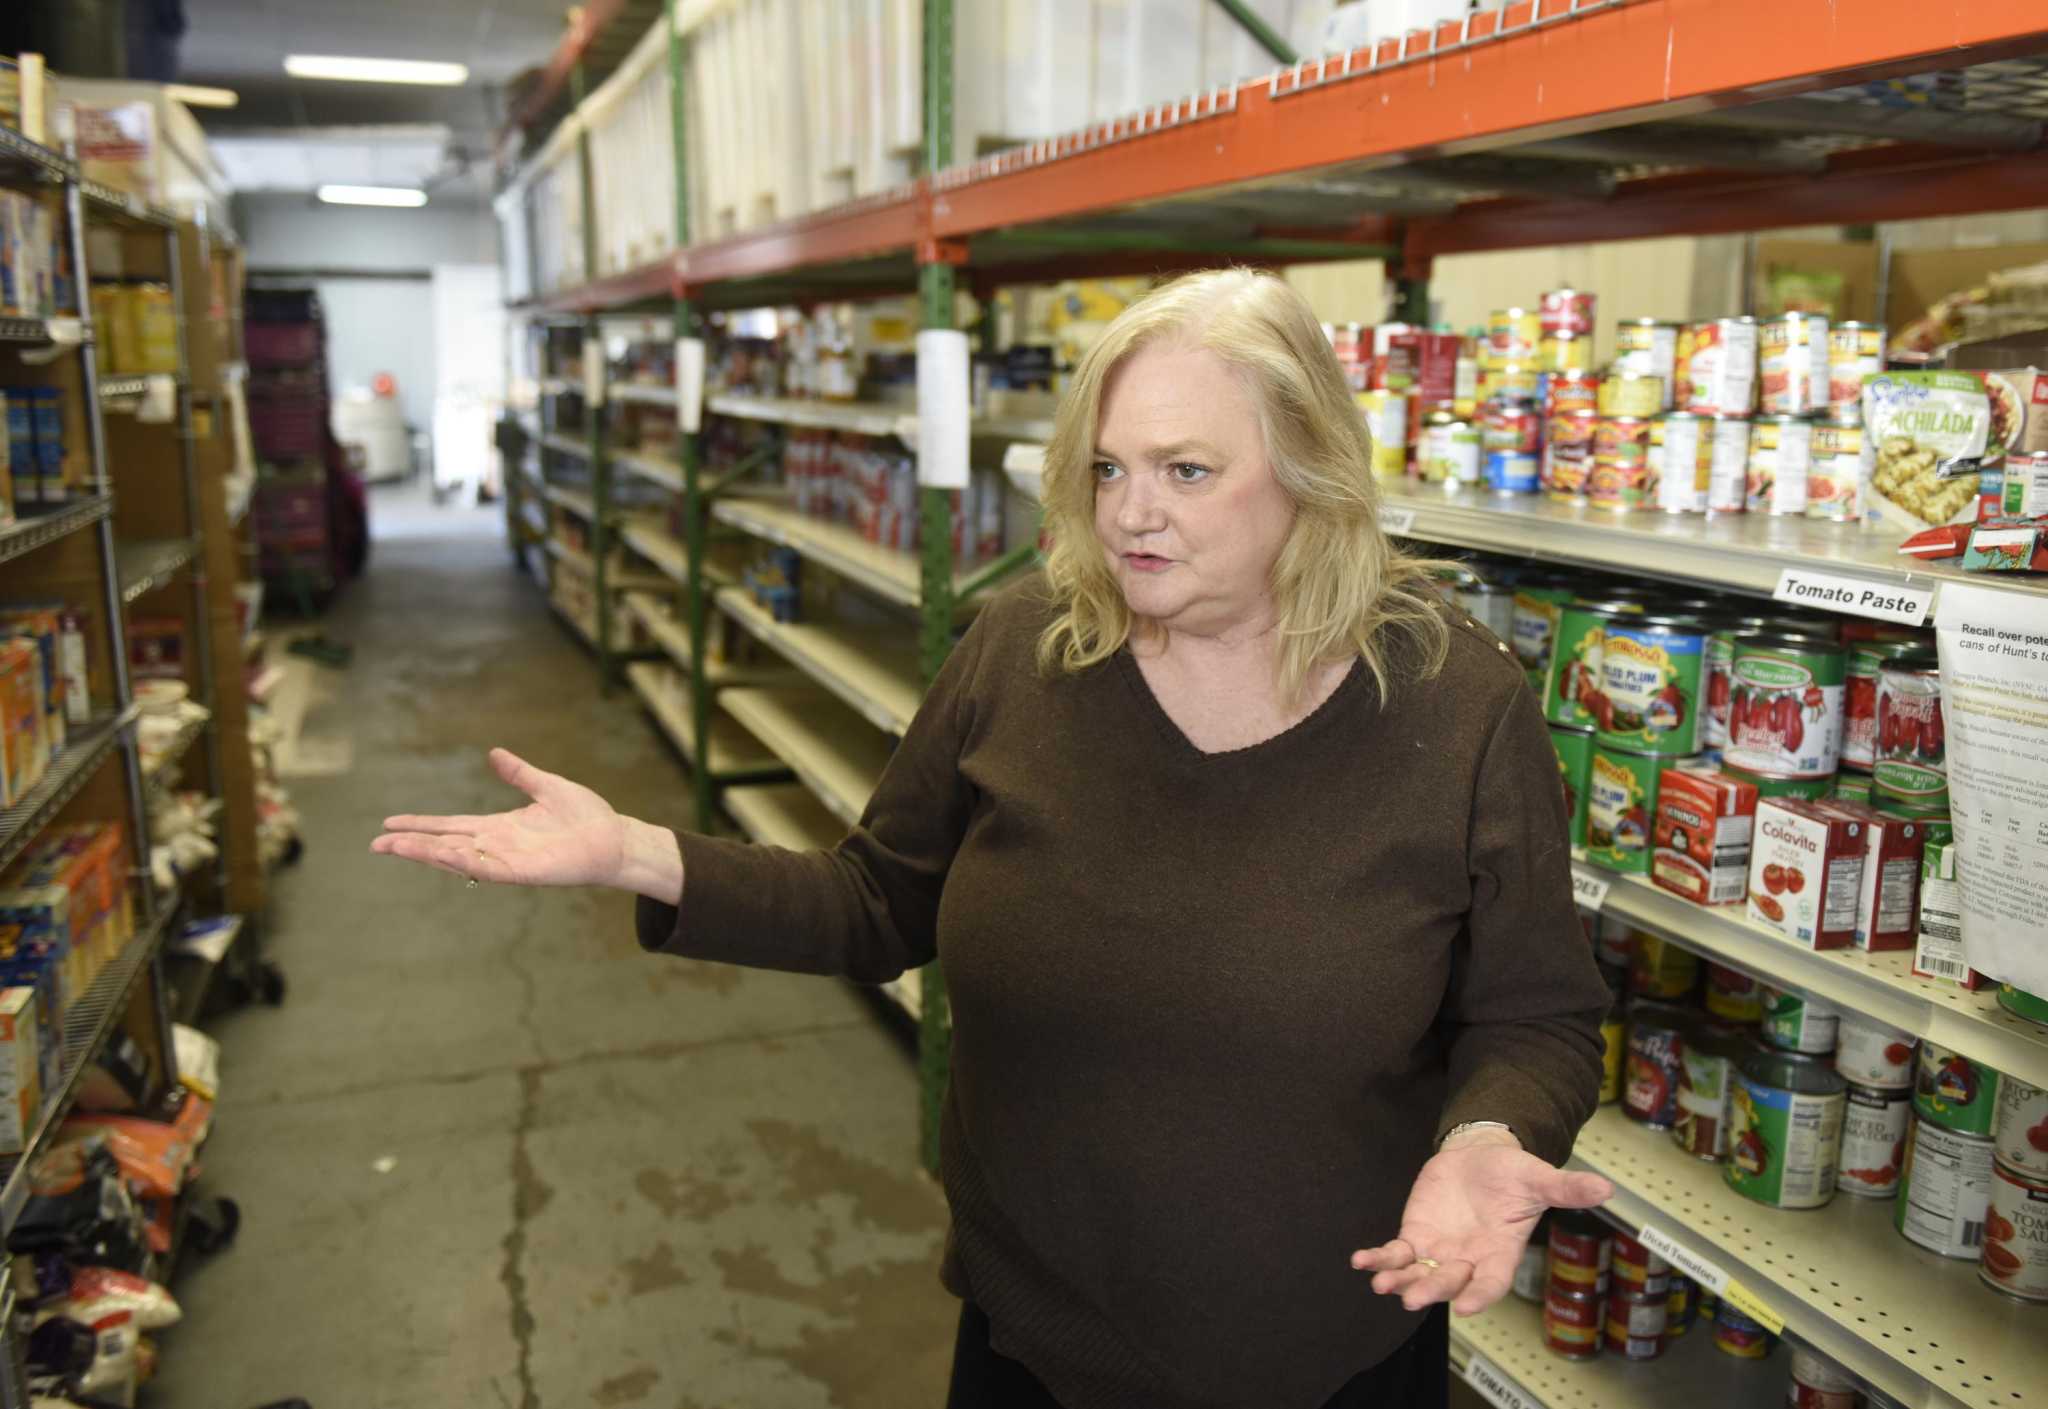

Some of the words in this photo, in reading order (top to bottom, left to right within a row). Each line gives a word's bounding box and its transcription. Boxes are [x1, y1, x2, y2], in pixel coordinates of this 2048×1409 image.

[1786, 579, 1854, 603] Tomato
[1860, 591, 1917, 613] Paste
[1962, 624, 1995, 637] Recall
[1998, 631, 2022, 641] over
[1960, 639, 1984, 651] cans
[1987, 643, 2000, 653] of
[2002, 644, 2038, 660] Hunt's
[1762, 820, 1817, 853] Colavita
[1644, 1229, 1671, 1252] Diced
[1671, 1247, 1717, 1285] Tomatoes
[1473, 1364, 1522, 1409] TOMATO
